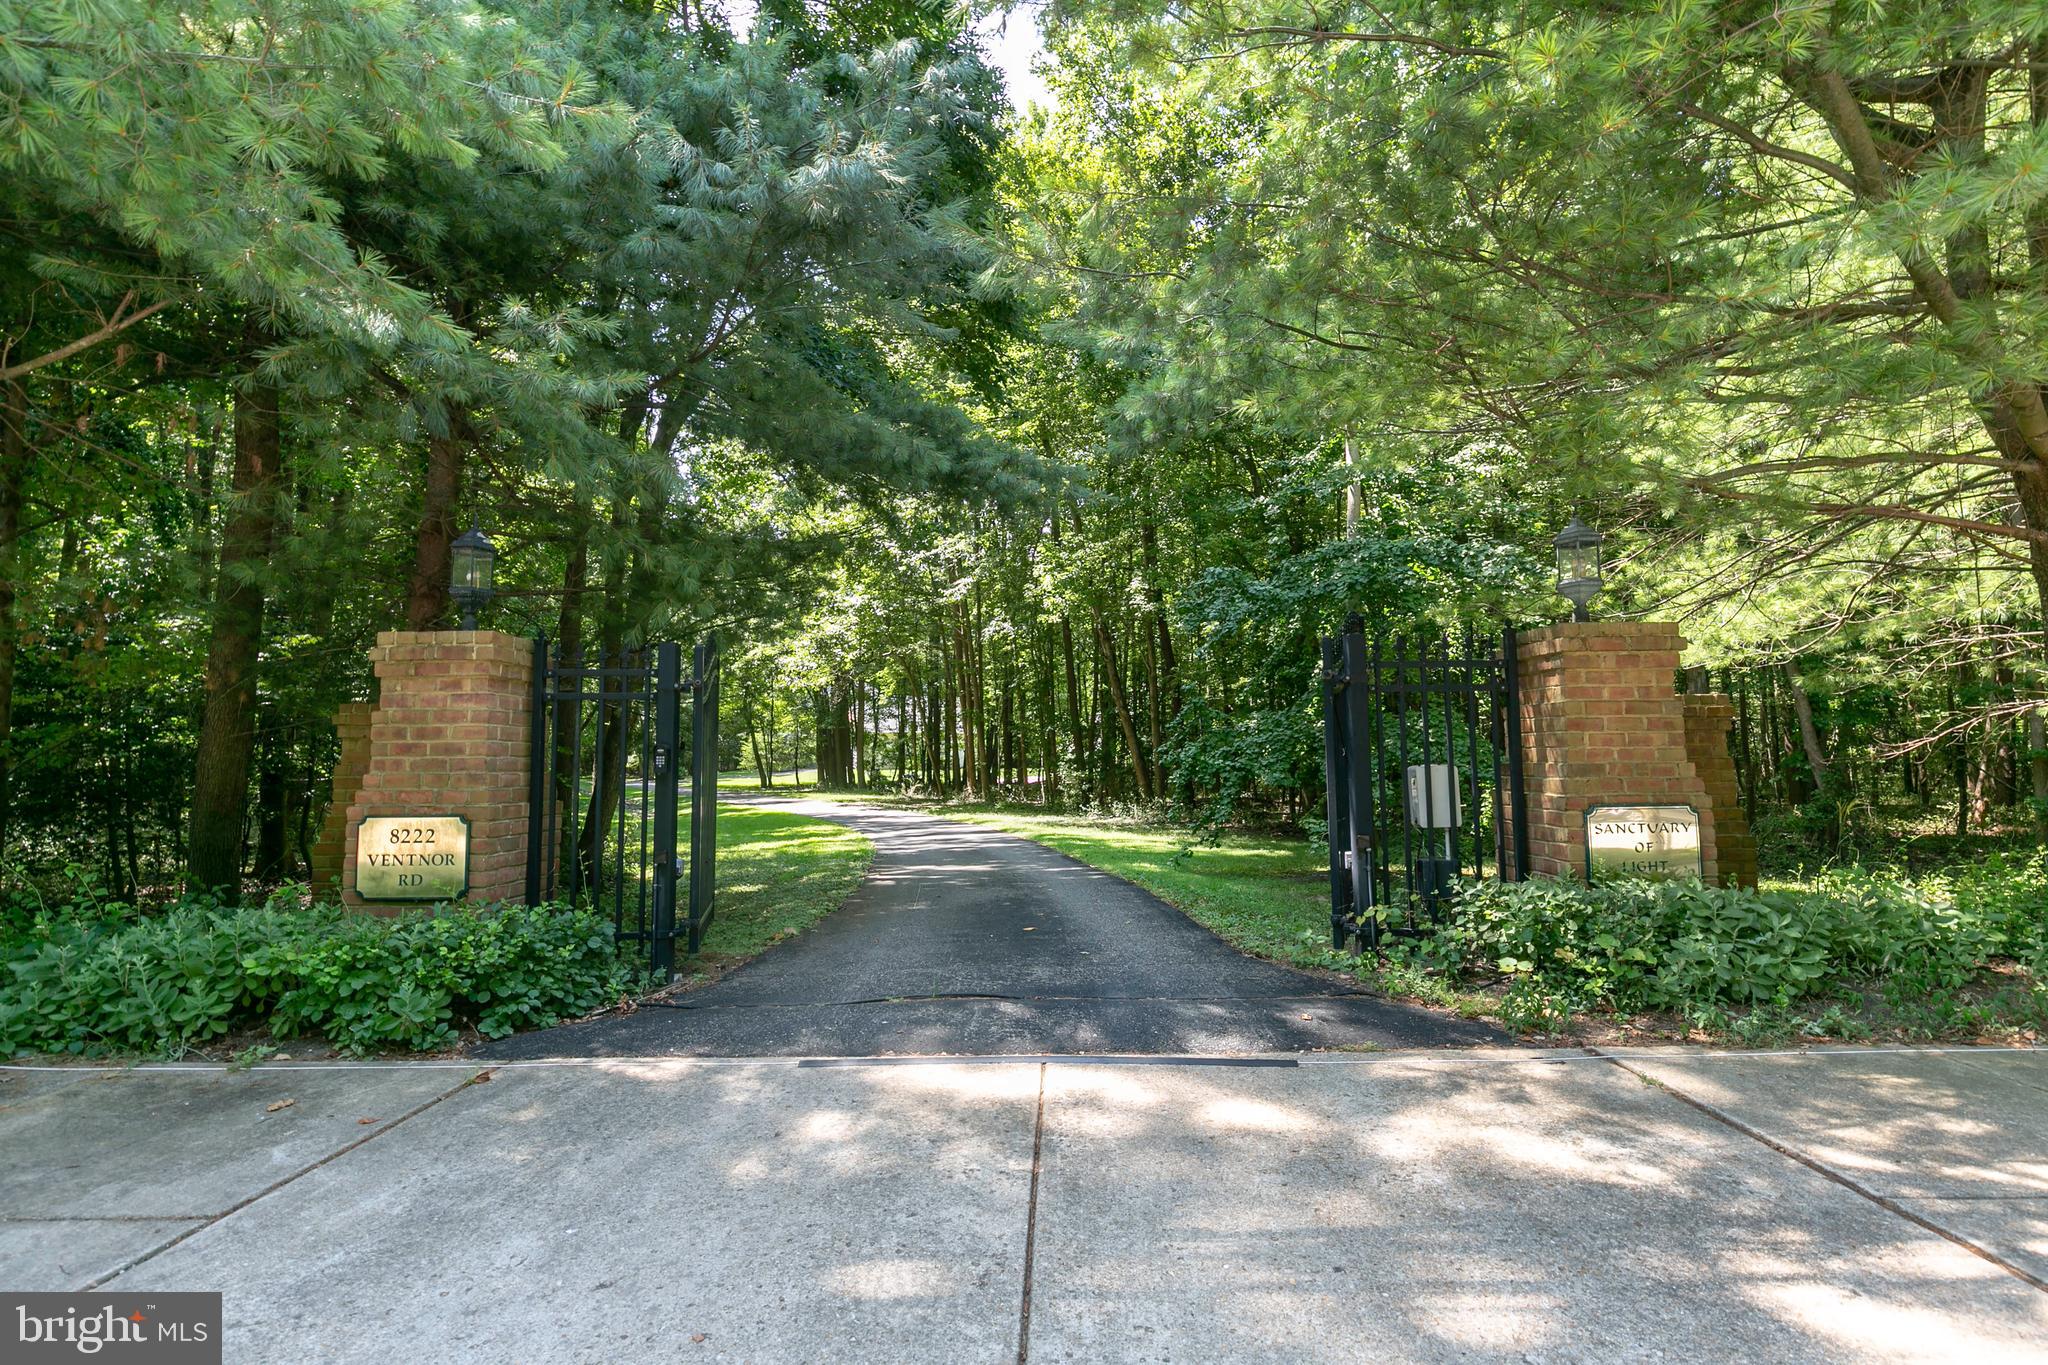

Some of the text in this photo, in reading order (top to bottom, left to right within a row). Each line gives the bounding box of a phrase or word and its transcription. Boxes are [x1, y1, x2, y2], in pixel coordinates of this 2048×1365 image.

[1594, 822, 1691, 835] SANCTUARY
[389, 828, 436, 845] 8222
[1634, 841, 1654, 854] OF
[367, 853, 456, 867] VENTNOR
[1622, 860, 1669, 873] LIGHT
[398, 873, 423, 887] RD
